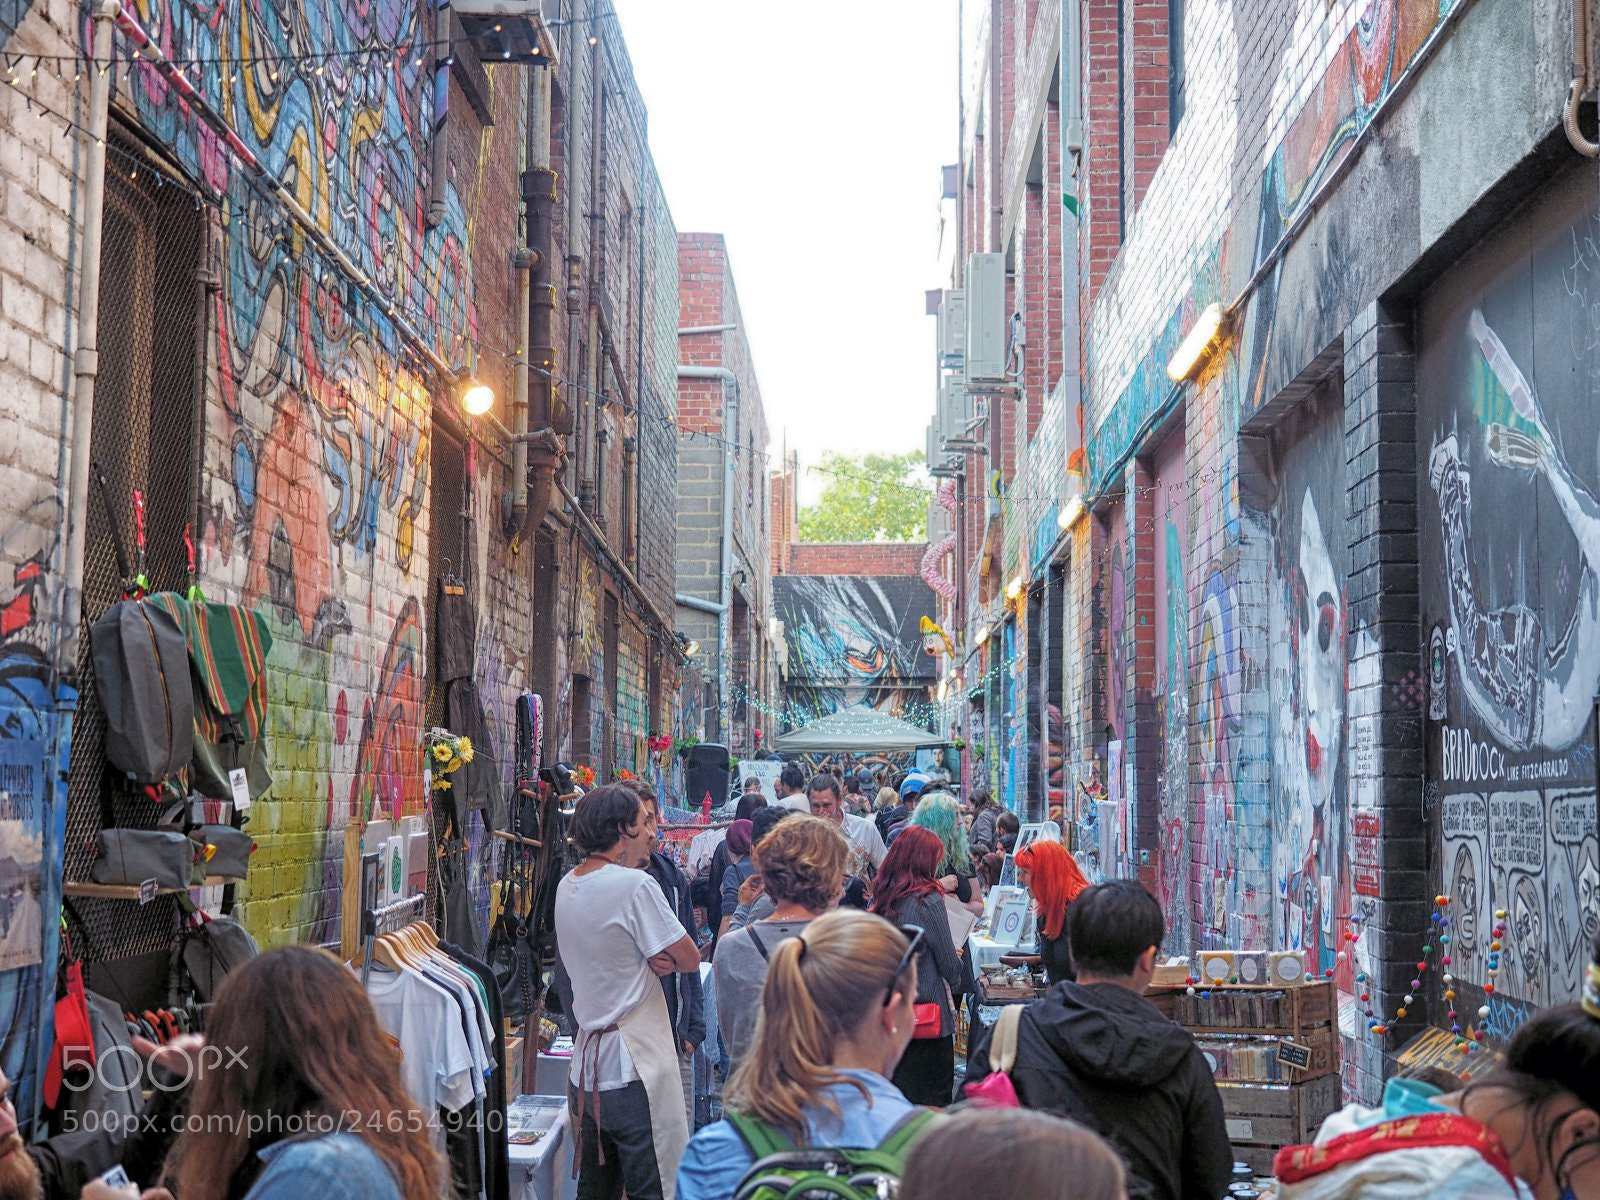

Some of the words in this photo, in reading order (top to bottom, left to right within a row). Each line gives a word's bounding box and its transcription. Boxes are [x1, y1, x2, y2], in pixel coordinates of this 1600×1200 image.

[1442, 725, 1504, 782] BRADDOCK
[1507, 766, 1519, 781] LIKE
[1522, 758, 1568, 779] FITZCARRALDO
[1502, 800, 1507, 816] IS
[1589, 803, 1596, 819] IS
[1519, 819, 1524, 834] IT
[1525, 820, 1543, 835] HAPPEN
[1556, 821, 1579, 837] WITHOUT
[1498, 849, 1507, 864] LIFE
[1508, 849, 1525, 863] WITHOUT
